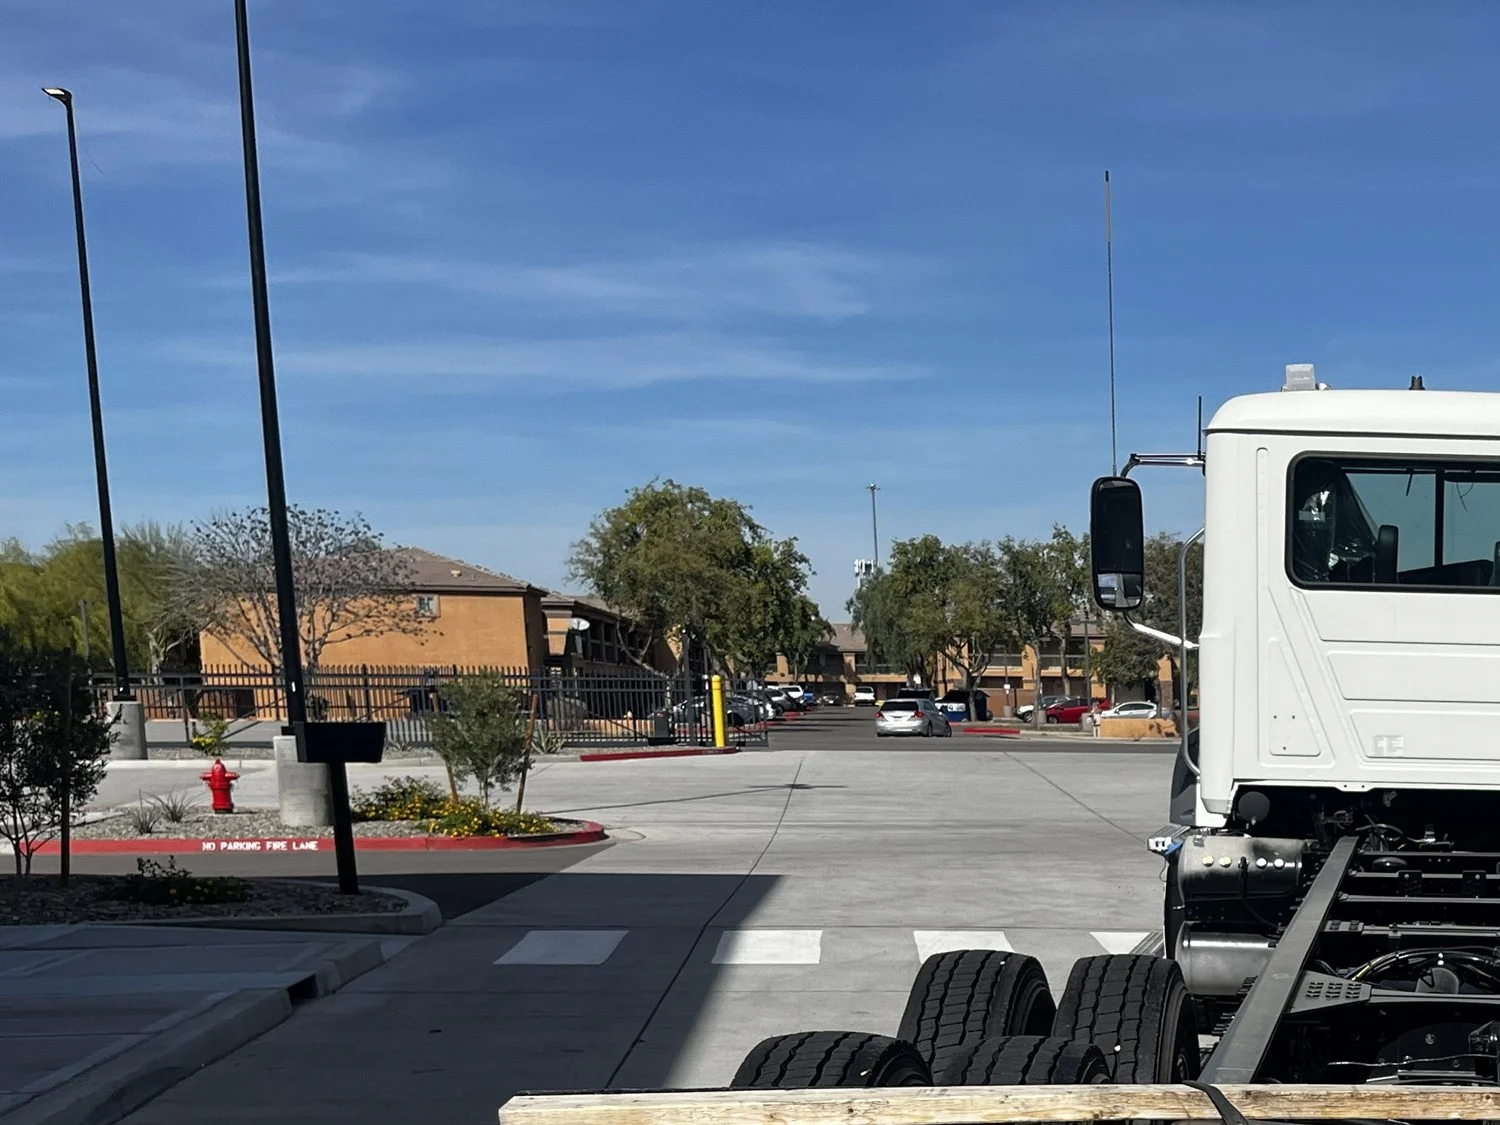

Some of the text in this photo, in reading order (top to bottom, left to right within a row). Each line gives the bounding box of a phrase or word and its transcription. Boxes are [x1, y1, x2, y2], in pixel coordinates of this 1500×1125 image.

[202, 840, 319, 851] NO PARKING FIRE LANE
